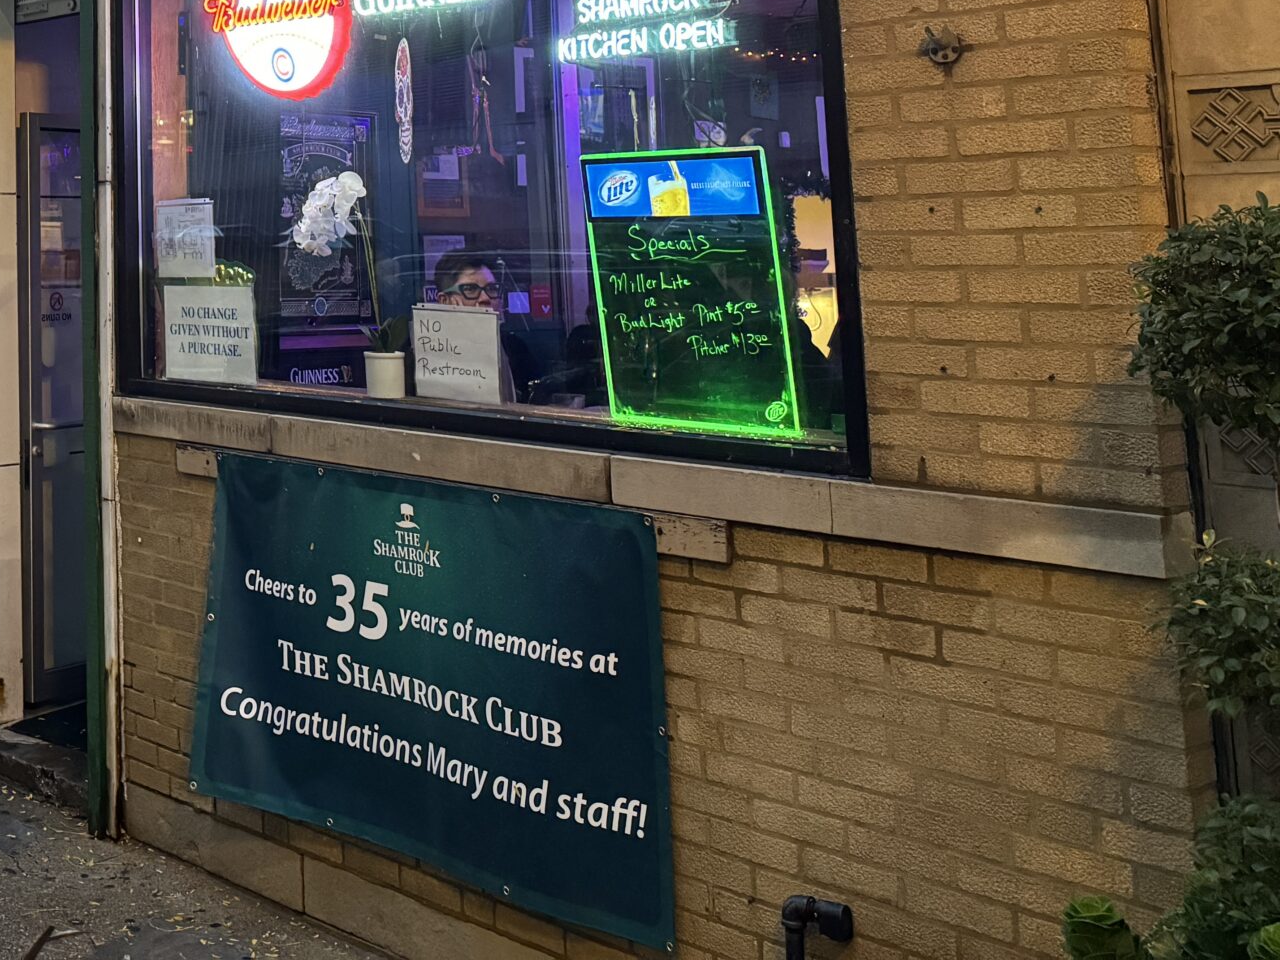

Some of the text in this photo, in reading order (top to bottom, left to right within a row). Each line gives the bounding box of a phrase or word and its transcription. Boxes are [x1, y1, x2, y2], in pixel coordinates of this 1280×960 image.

[558, 19, 724, 62] KITCHEN OPEN
[606, 178, 634, 203] Lite
[627, 224, 711, 258] Specials
[609, 271, 692, 295] Miller Lite
[181, 306, 238, 321] NO CHANGE
[614, 313, 686, 334] Bud Light
[692, 304, 724, 328] Pint
[169, 323, 250, 340] GIVEN WITHOUT
[419, 318, 442, 333] NO
[179, 341, 242, 358] A PURCHASE.
[417, 336, 462, 356] Public
[686, 335, 730, 361] Pitcher
[290, 366, 340, 385] GUINNESS
[416, 357, 486, 380] Restroom
[395, 530, 421, 547] THE
[373, 538, 441, 569] SHAMROCK
[394, 559, 424, 578] CLUB
[245, 568, 619, 676] Cheers to 35 years of memories at
[278, 639, 564, 748] THE SHAMROCK CLUB
[219, 685, 649, 839] Congratulations Mary and staff!
